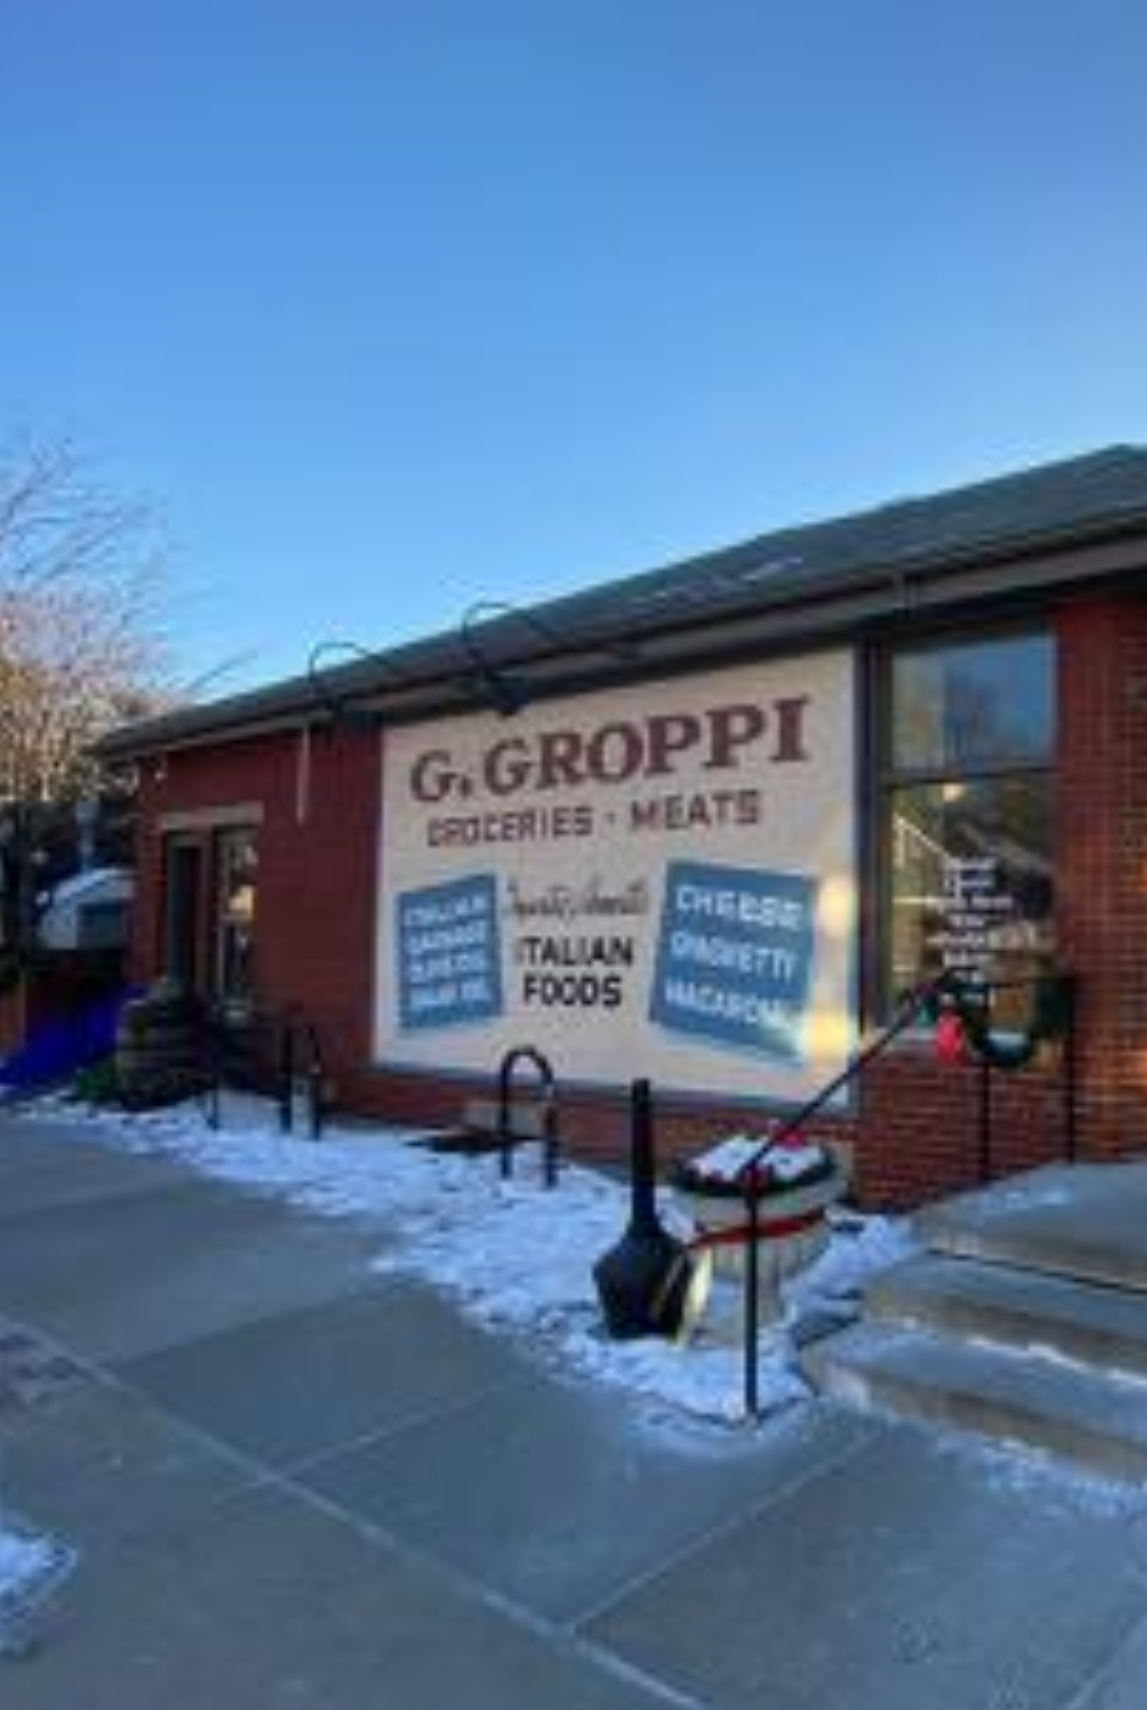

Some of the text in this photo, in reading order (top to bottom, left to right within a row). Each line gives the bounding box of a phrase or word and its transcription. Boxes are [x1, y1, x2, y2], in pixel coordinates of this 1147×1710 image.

[409, 694, 811, 803] G. GROPPI
[427, 789, 761, 848] GROCERIES MEATS
[513, 935, 635, 968] ITALIAN
[523, 971, 623, 1010] FOODS
